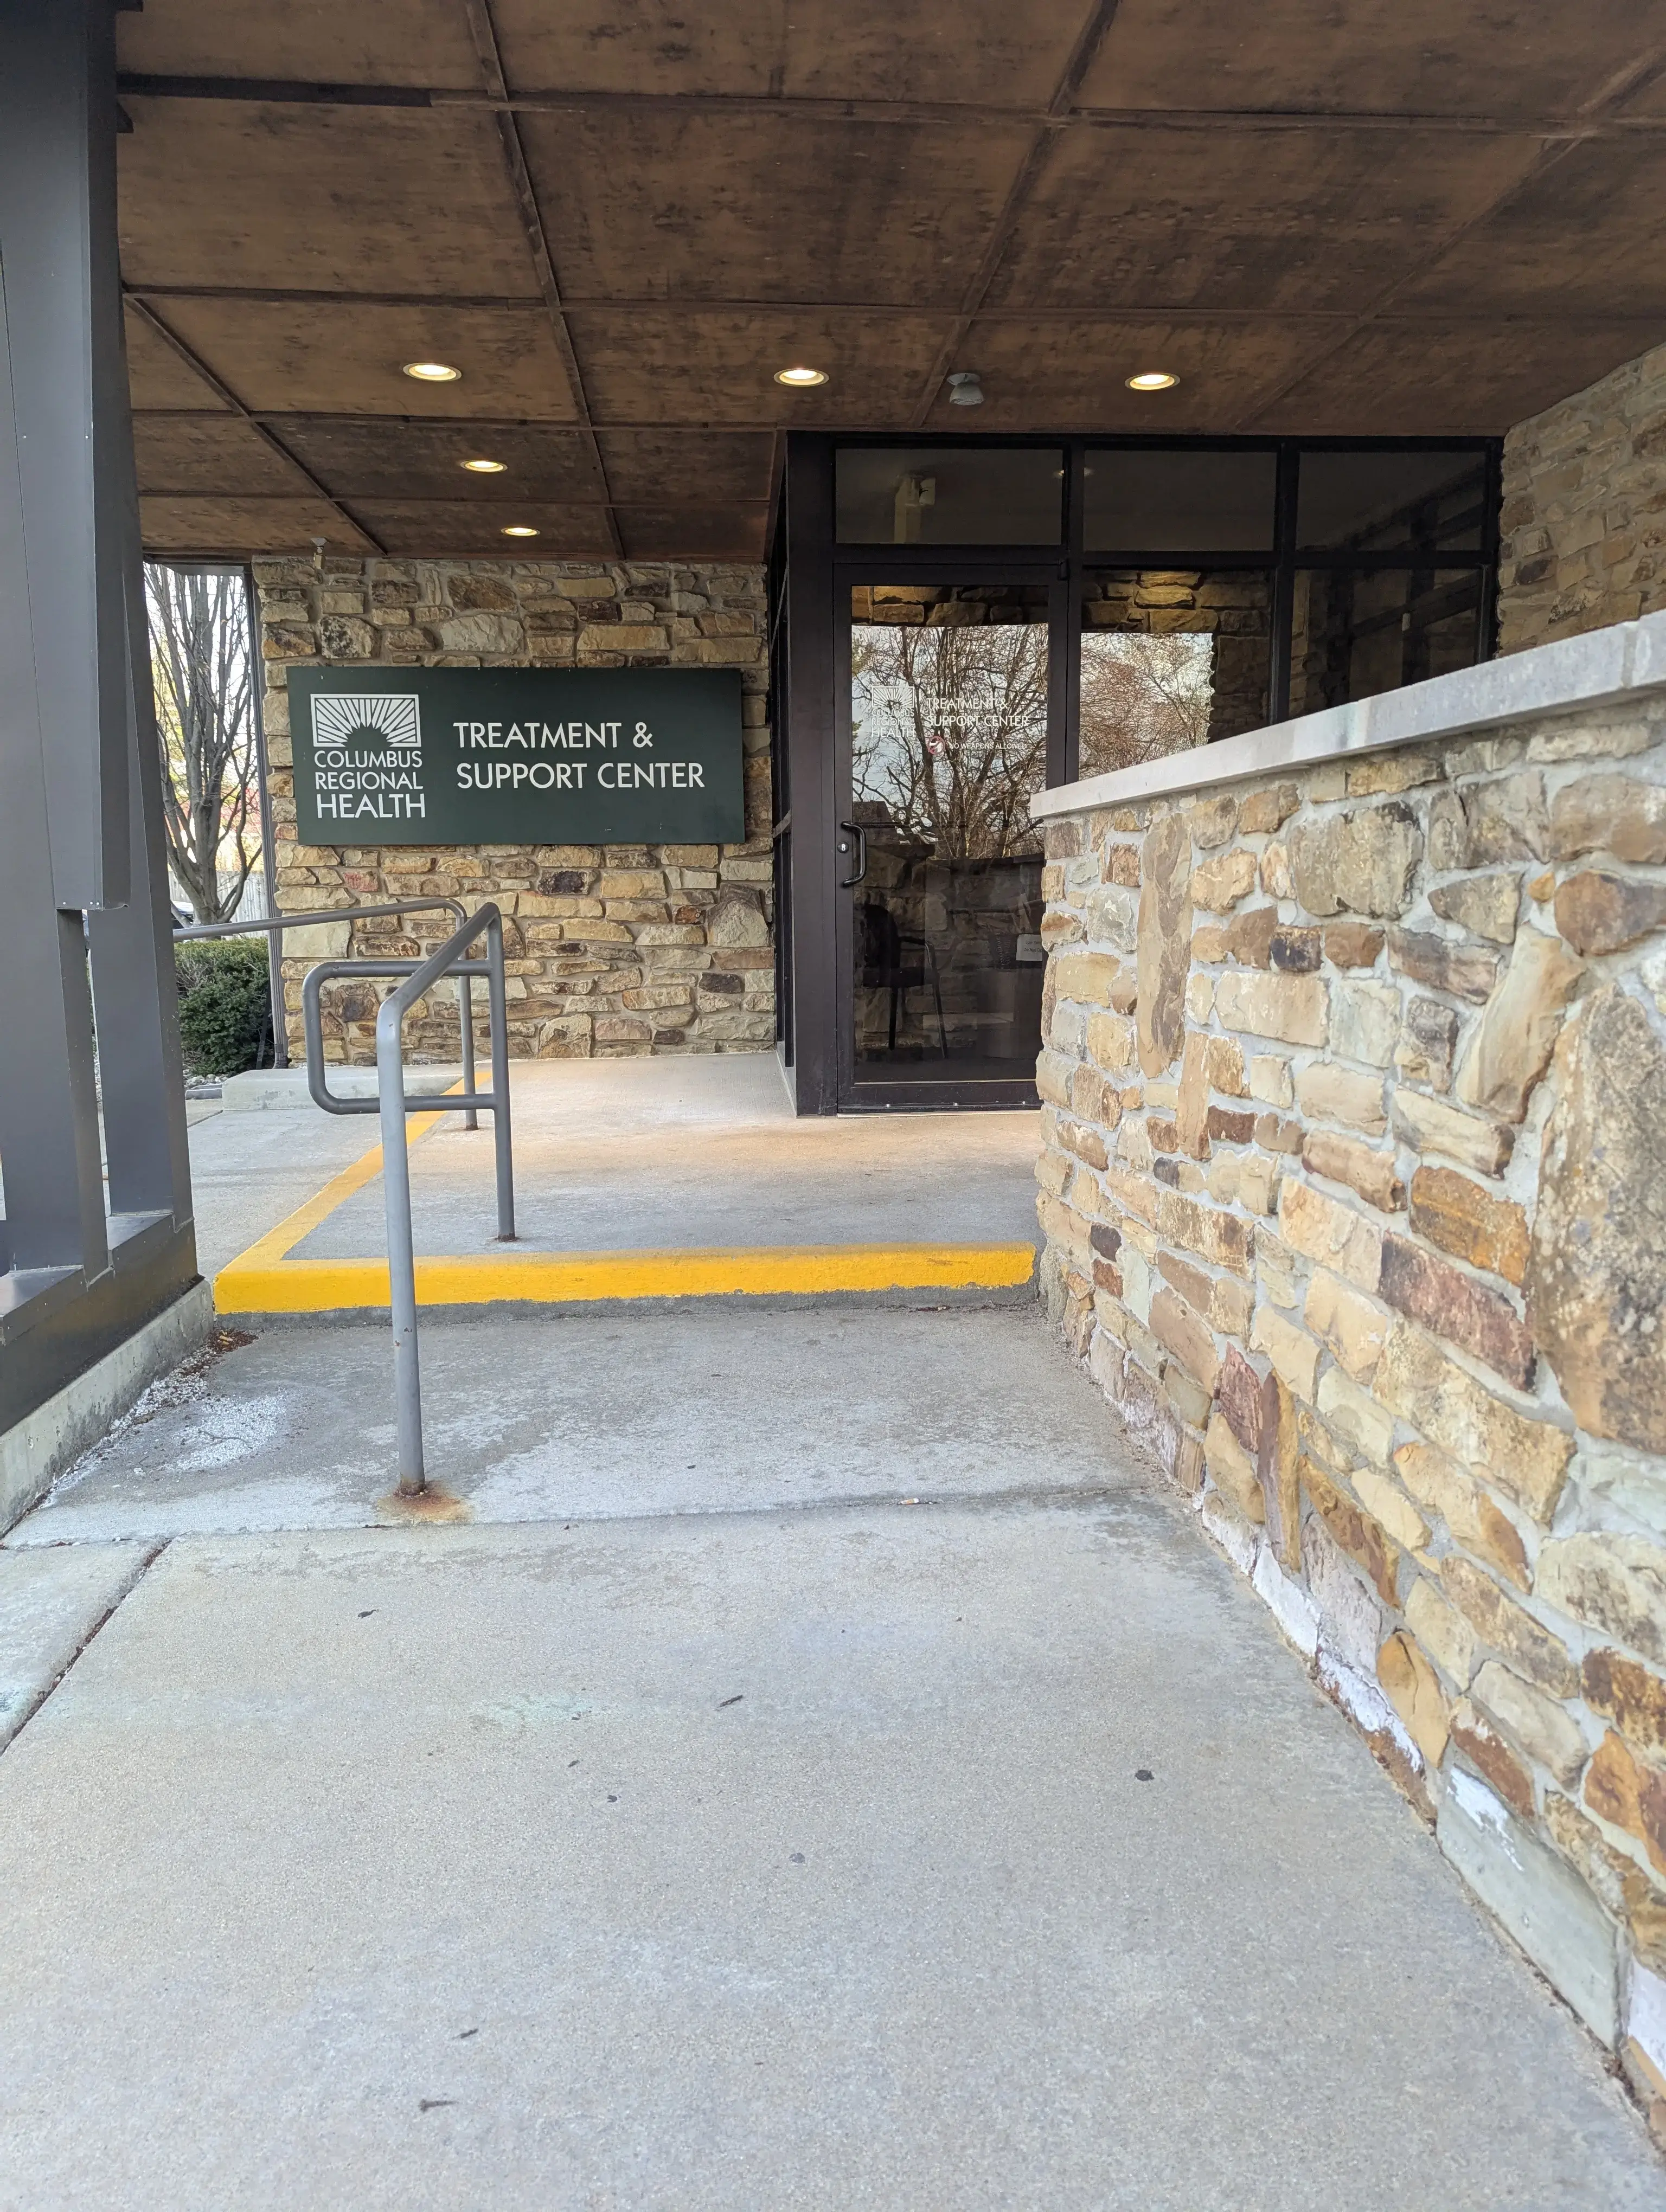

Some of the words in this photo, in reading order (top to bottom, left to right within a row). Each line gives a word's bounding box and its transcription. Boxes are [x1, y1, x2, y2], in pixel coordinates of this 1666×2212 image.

[872, 709, 915, 717] COLUMBUS
[926, 698, 996, 709] TREATMENT
[1000, 698, 1008, 710] &
[926, 715, 980, 727] SUPPORT
[984, 715, 1028, 727] CENTER
[453, 722, 622, 748] TREATMENT
[632, 722, 653, 748] &
[872, 727, 915, 737] HEALTH
[314, 750, 422, 768] COLUMBUS
[315, 771, 424, 790] REGIONAL
[457, 762, 587, 789] SUPPORT
[597, 762, 705, 789] CENTER
[317, 793, 426, 819] HEALTH
